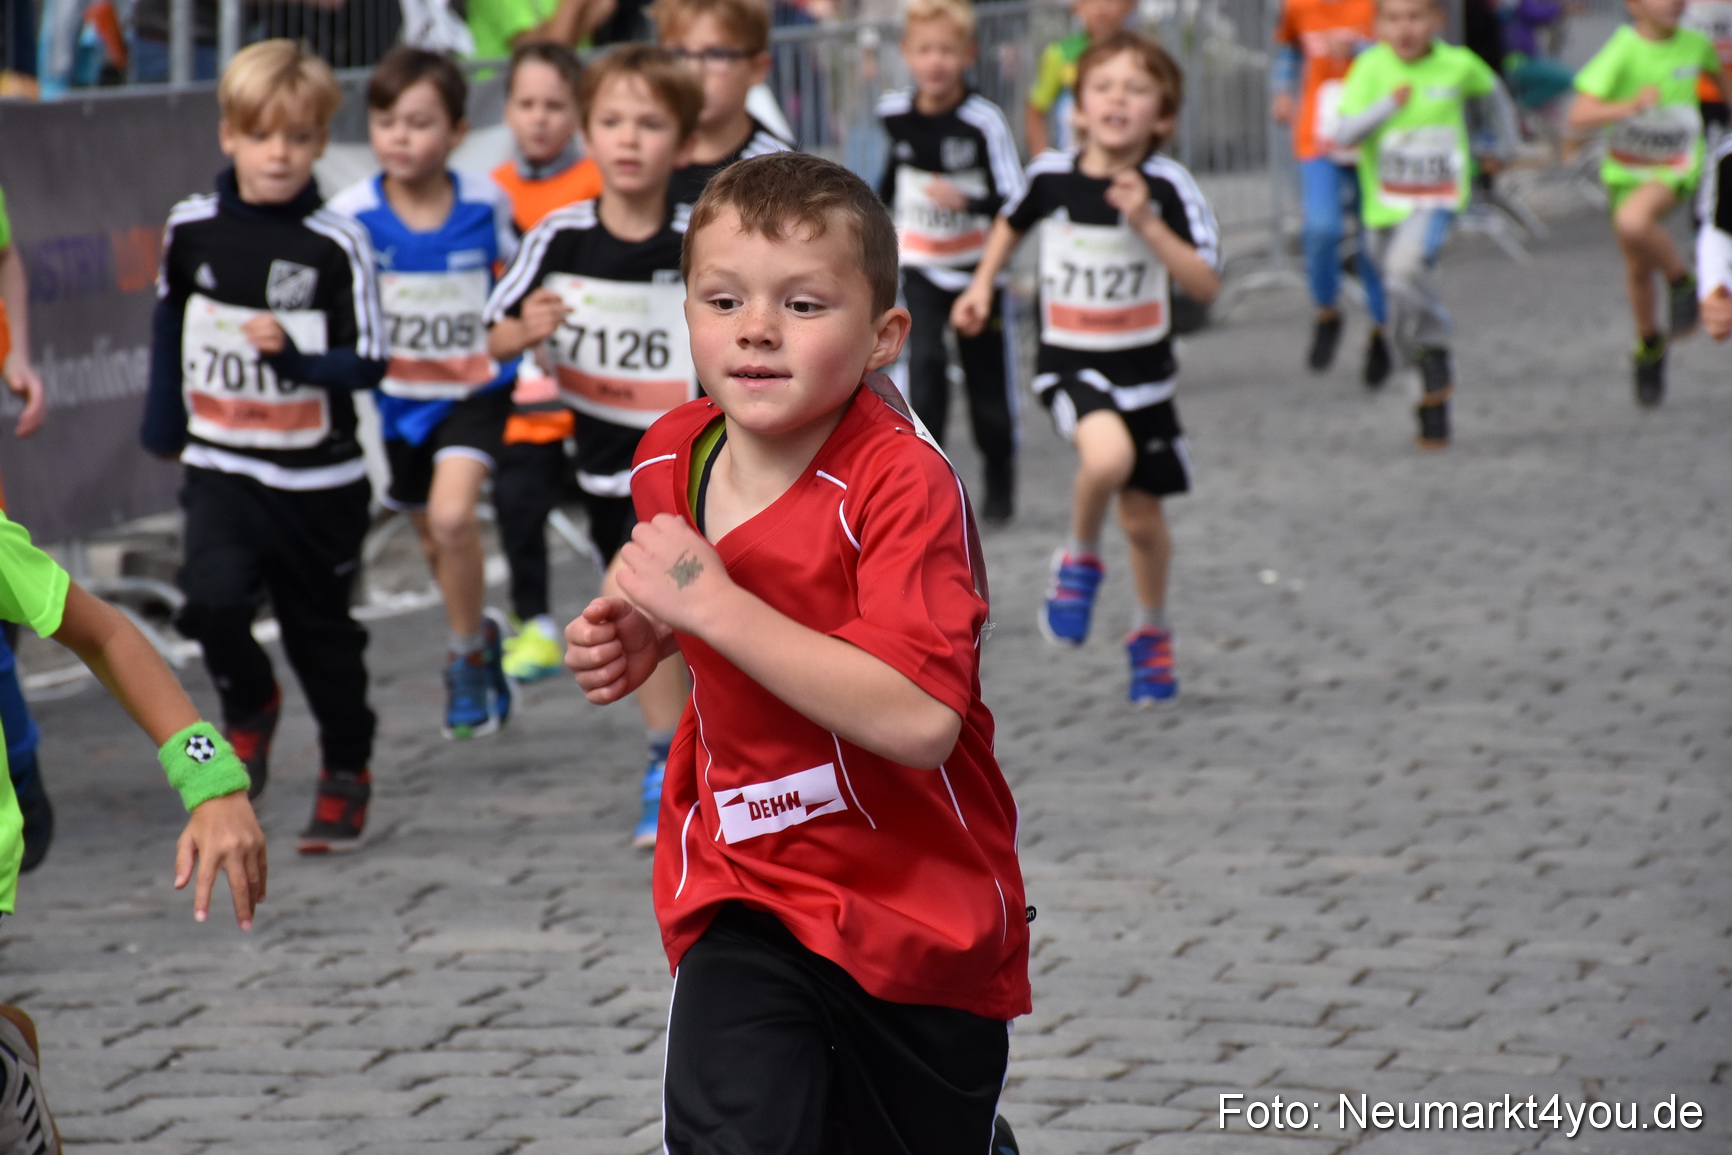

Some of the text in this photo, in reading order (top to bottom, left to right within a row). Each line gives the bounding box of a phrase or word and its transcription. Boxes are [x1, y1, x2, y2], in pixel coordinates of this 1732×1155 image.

[1061, 261, 1147, 299] 7127
[561, 320, 671, 370] 7126
[748, 790, 802, 821] DEHN
